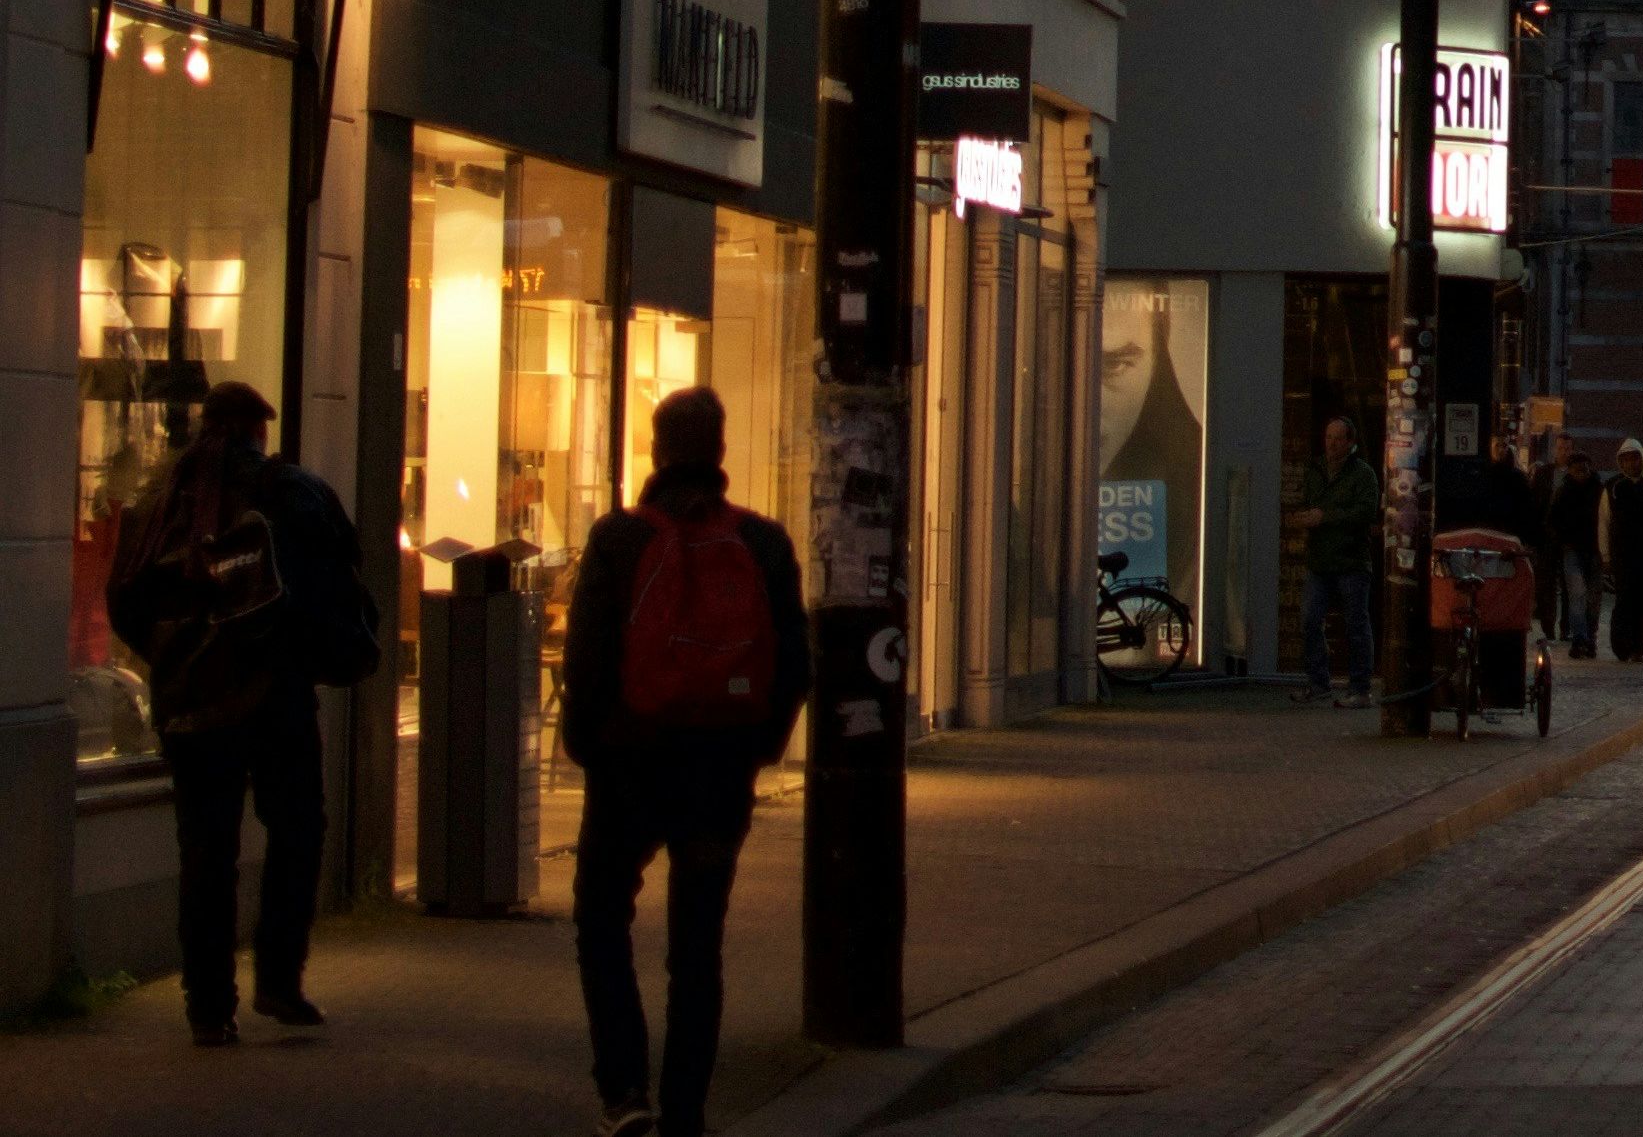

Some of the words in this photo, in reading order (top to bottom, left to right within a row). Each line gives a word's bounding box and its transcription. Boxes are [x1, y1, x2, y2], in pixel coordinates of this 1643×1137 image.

[1434, 62, 1503, 131] RAIN
[1108, 291, 1200, 312] WINTER
[1098, 510, 1155, 543] SS
